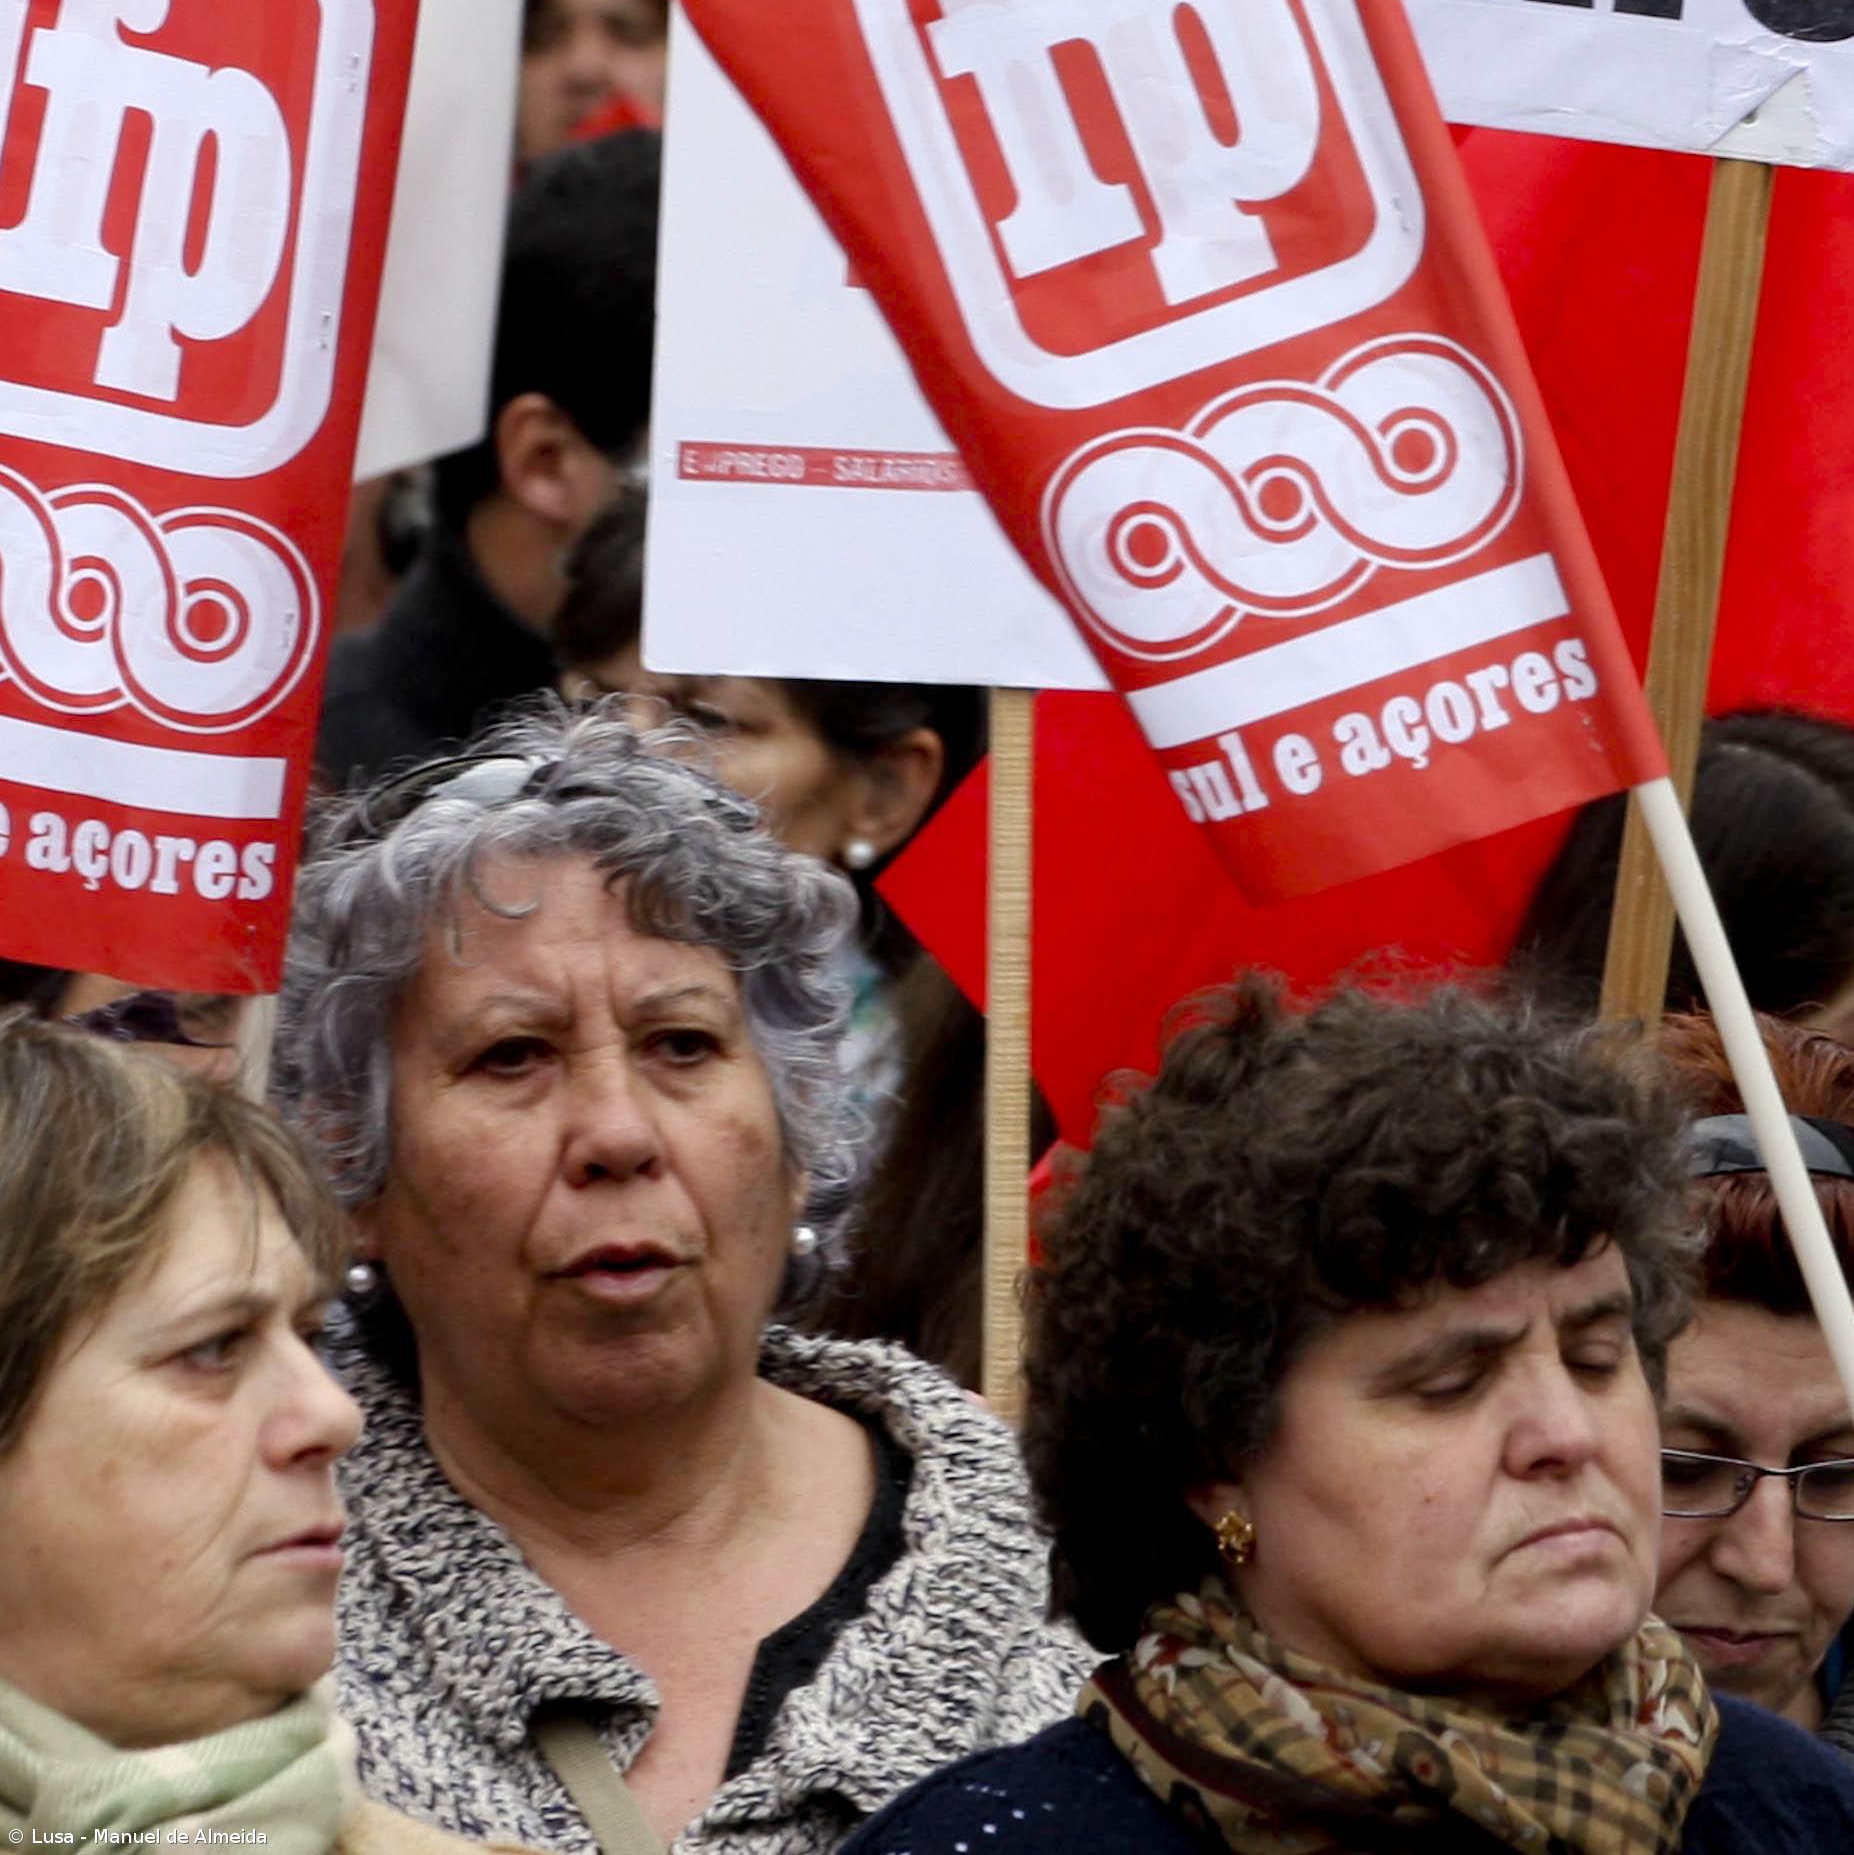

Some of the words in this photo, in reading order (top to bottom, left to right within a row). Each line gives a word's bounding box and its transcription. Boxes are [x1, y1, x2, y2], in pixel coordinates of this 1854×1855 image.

[1168, 731, 1270, 824] sul
[1272, 733, 1323, 796] e
[1333, 638, 1599, 777] açores
[24, 811, 277, 900] açores
